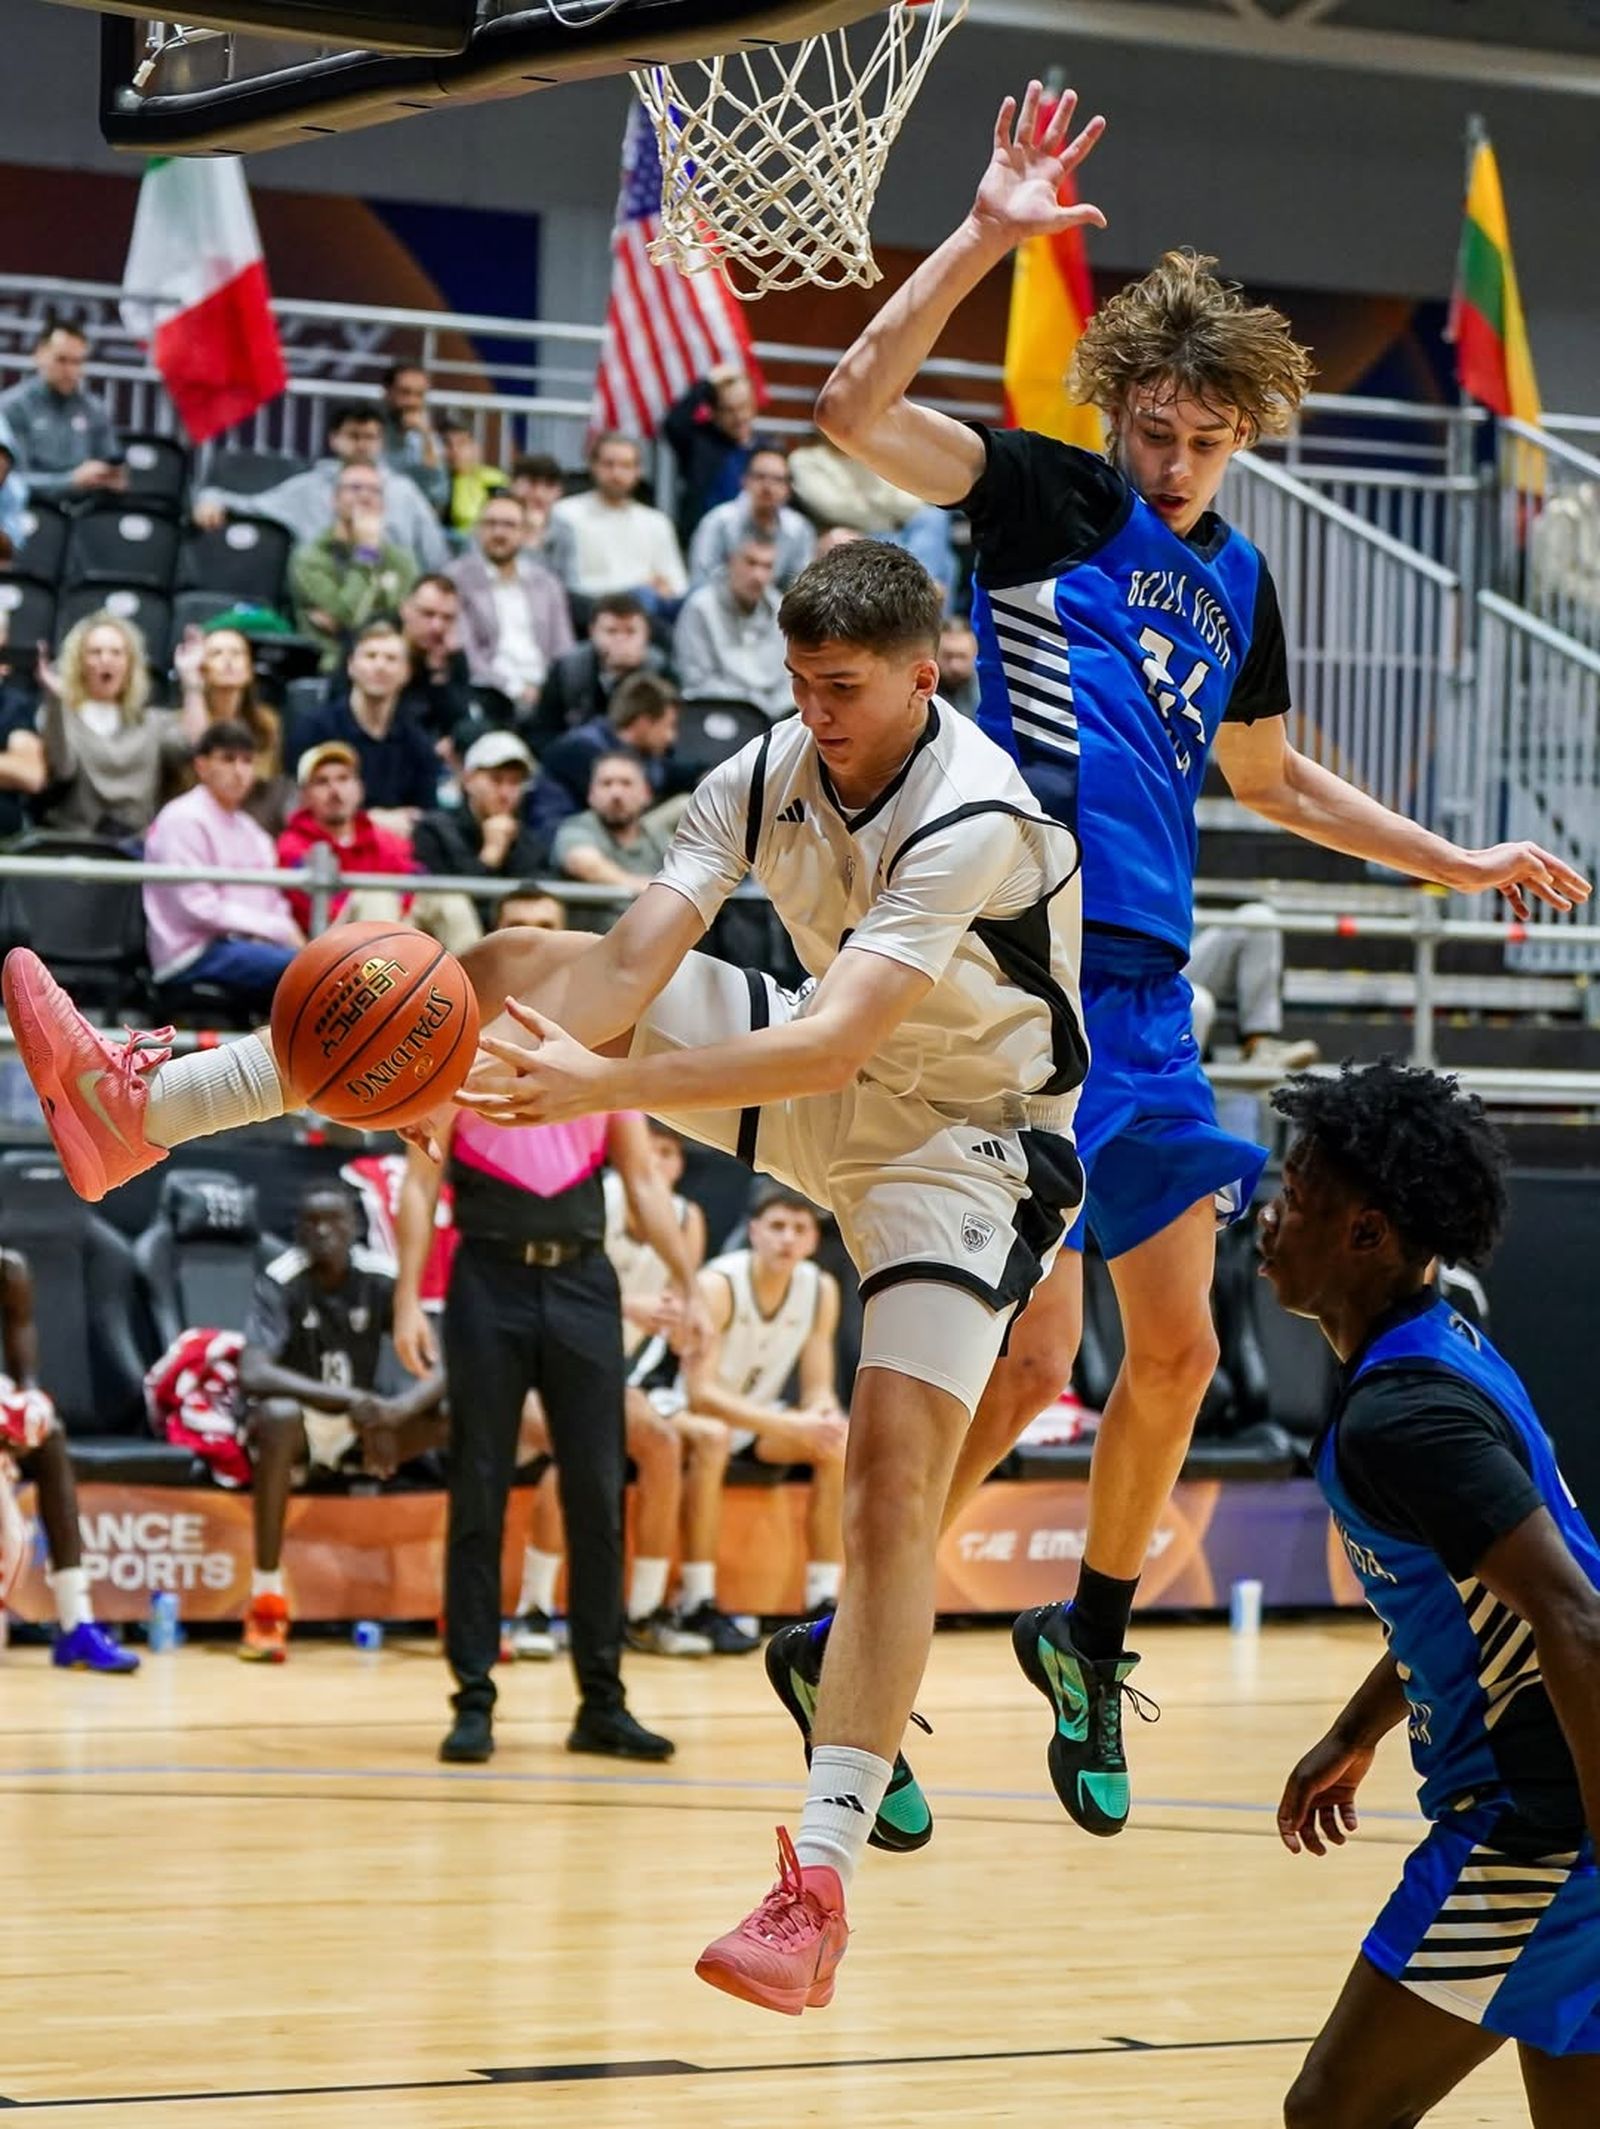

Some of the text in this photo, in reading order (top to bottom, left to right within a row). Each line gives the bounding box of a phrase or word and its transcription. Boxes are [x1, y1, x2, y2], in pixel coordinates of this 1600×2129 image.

[1127, 570, 1231, 670] BELLA VISTA
[321, 959, 410, 1059] LEGACY
[346, 984, 454, 1104] SPALDING
[46, 1552, 235, 1591] PORTS
